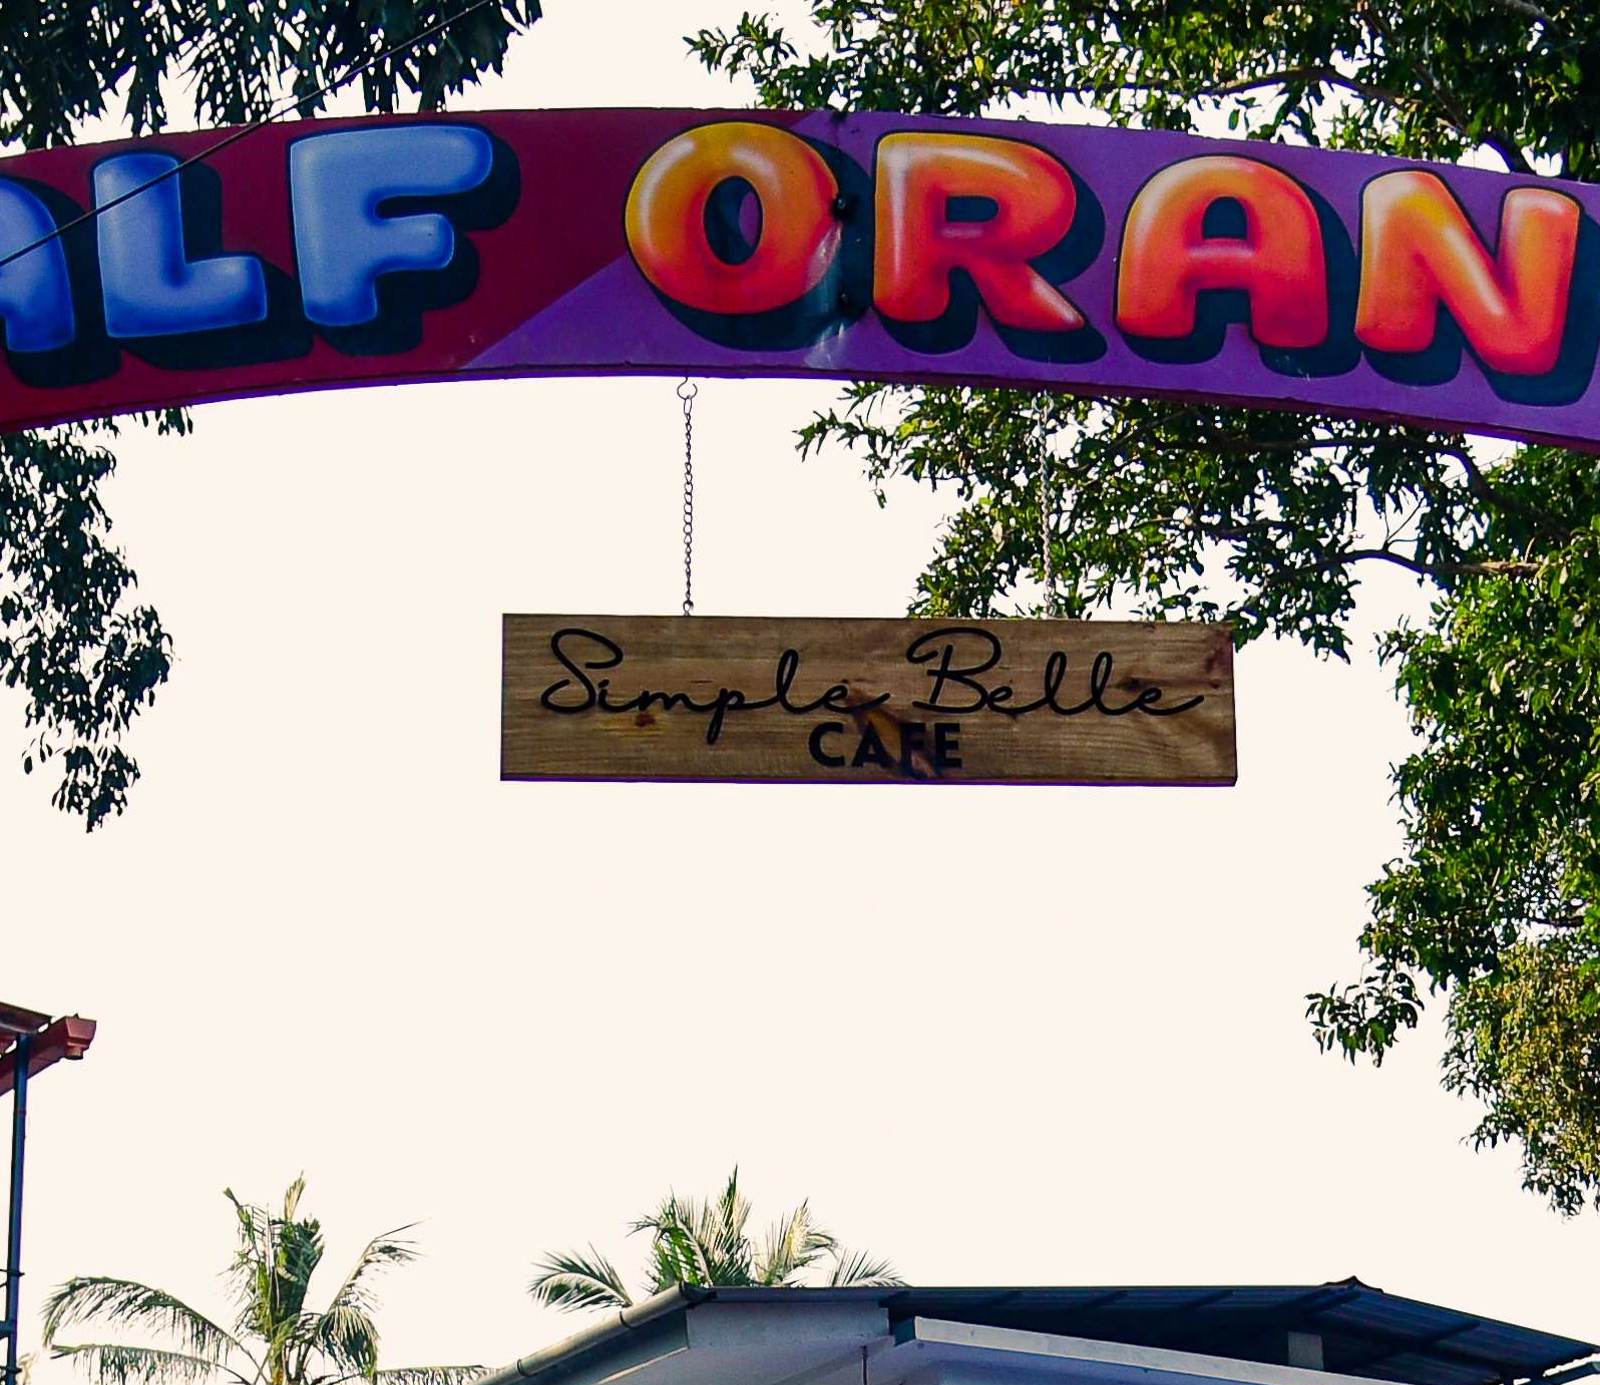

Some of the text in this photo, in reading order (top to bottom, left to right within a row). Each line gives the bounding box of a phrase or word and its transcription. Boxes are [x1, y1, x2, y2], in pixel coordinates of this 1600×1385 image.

[625, 122, 1581, 375] ORAN
[540, 626, 1206, 746] Simple Belle
[807, 721, 965, 770] CAFE
